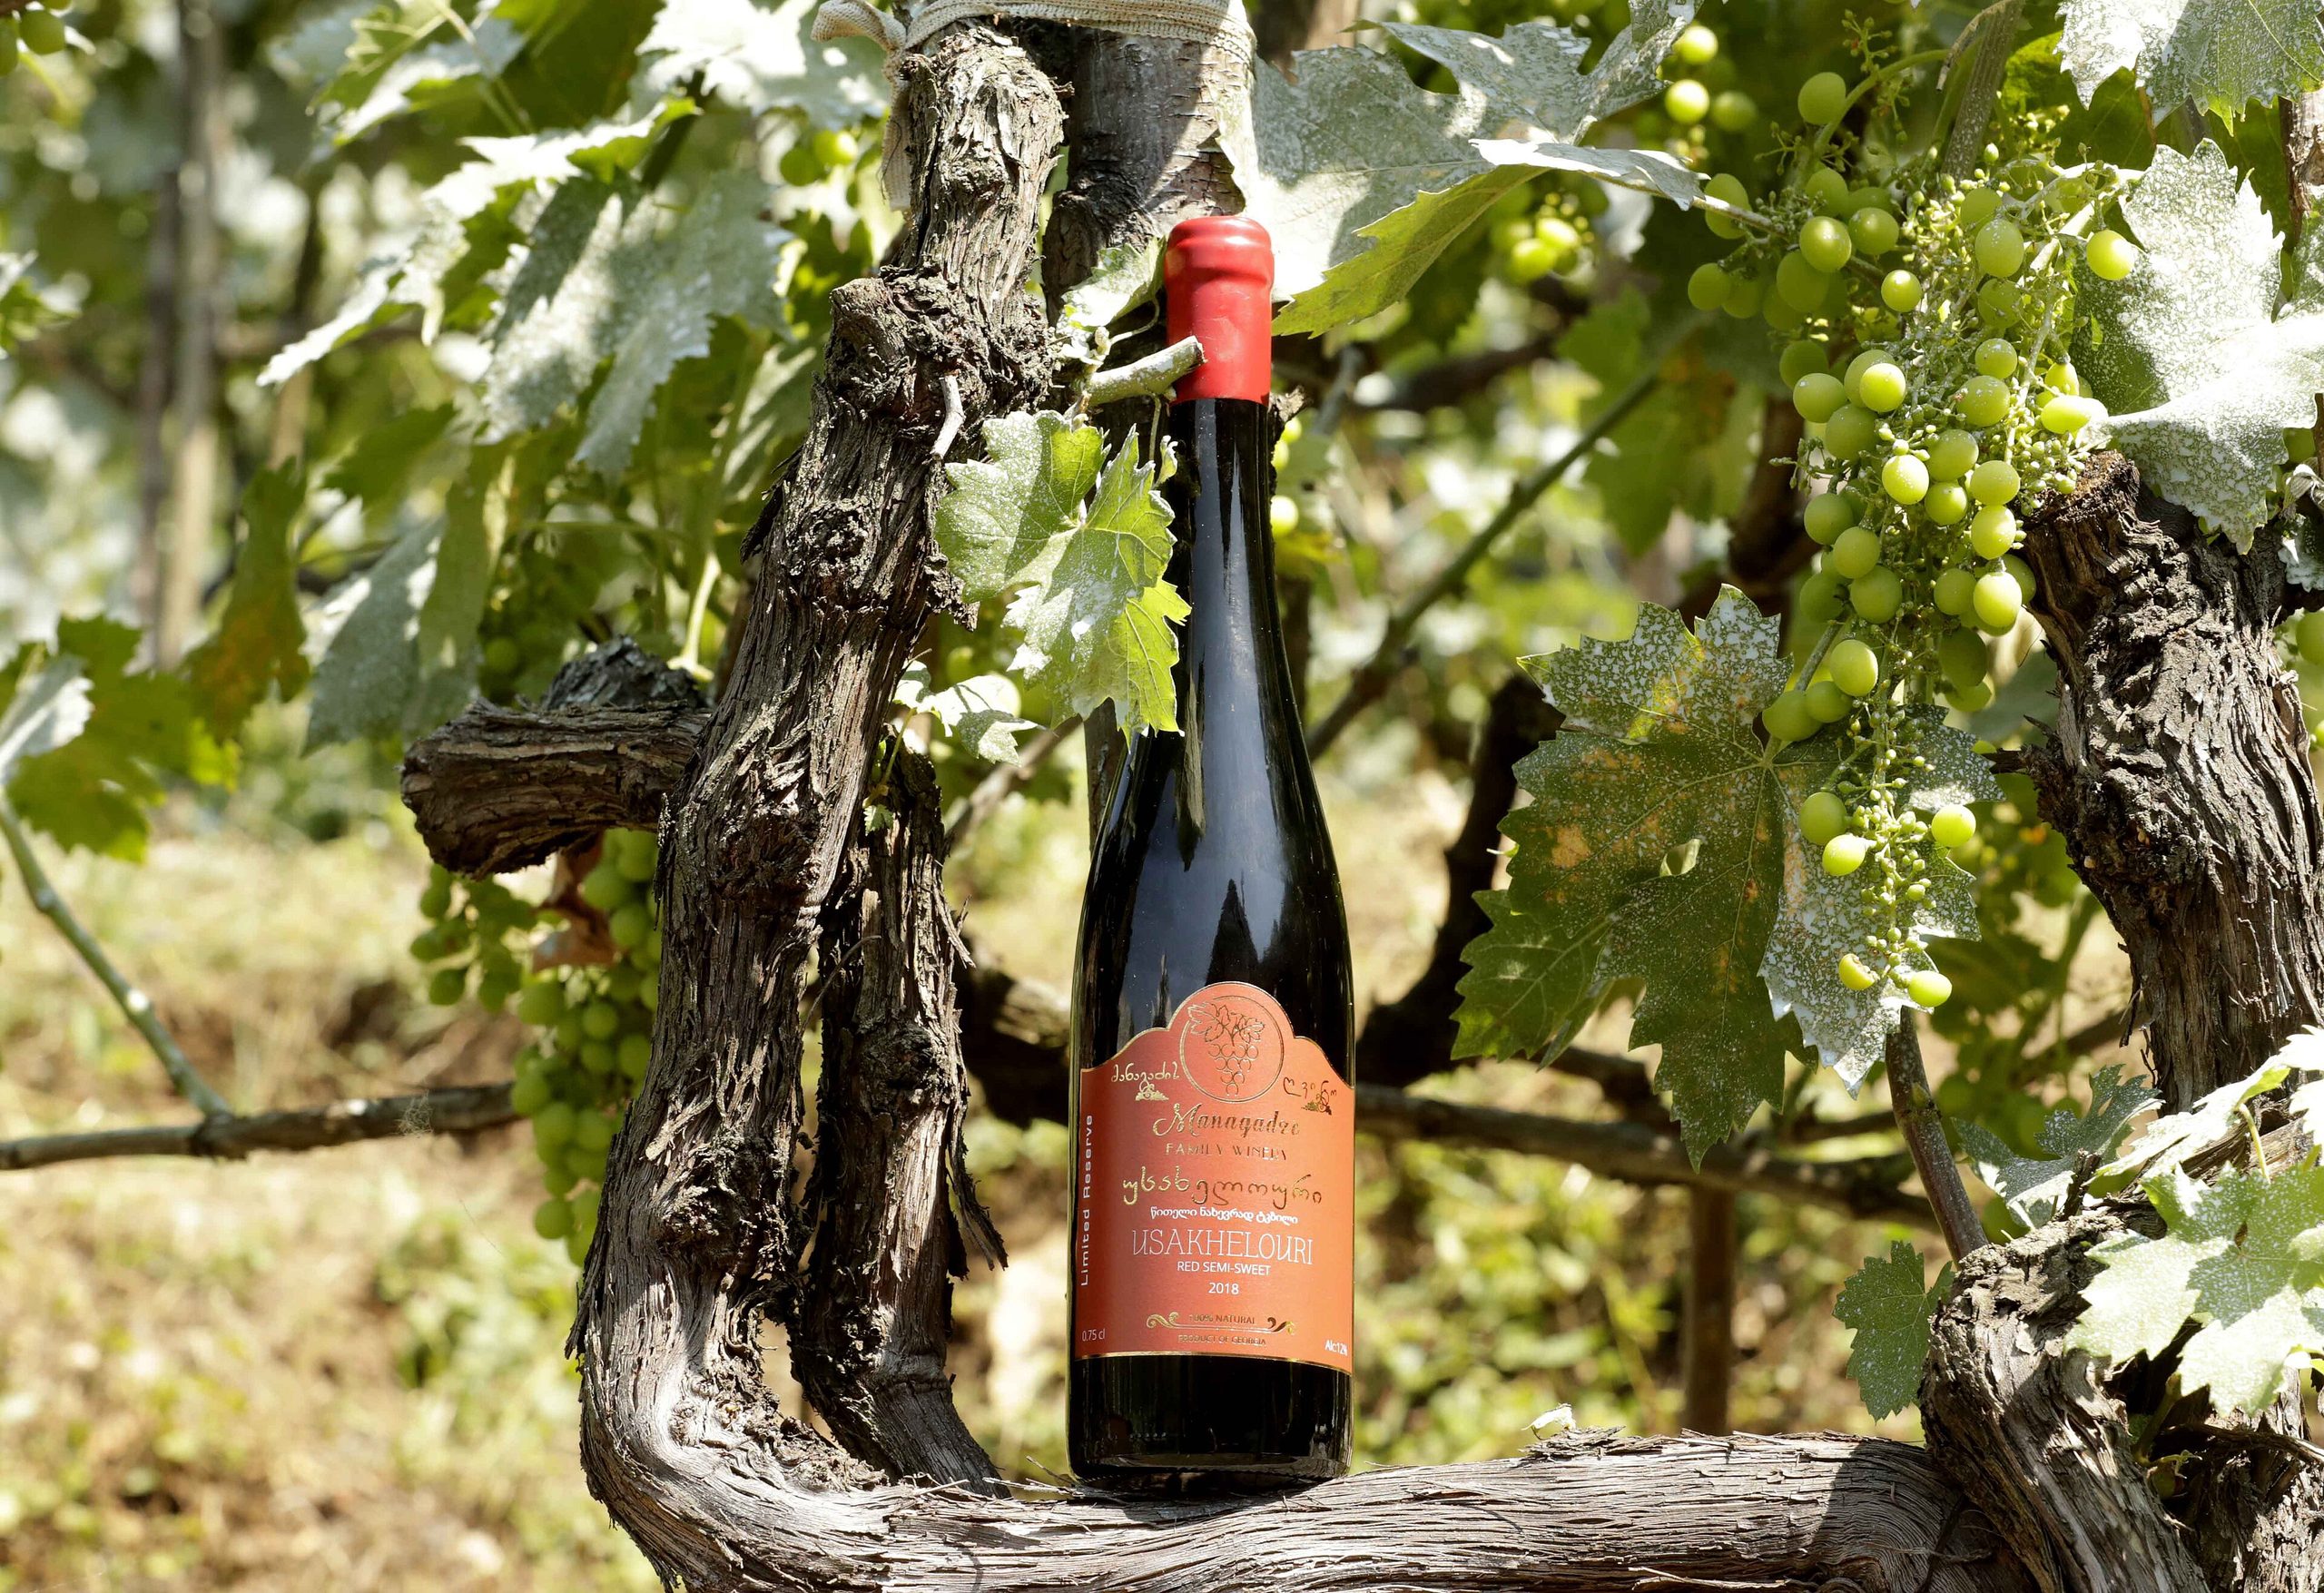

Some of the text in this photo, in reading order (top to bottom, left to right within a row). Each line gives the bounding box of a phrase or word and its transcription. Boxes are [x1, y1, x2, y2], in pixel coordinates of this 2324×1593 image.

[1152, 1102, 1301, 1137] Managadze
[1165, 1142, 1223, 1156] FAMILY
[1122, 1165, 1323, 1210] უსახელოური
[1080, 1115, 1093, 1286] Limited Reserve
[1150, 1205, 1299, 1226] წითელი ნახევრად ტკბილი
[1132, 1228, 1314, 1265] USAKHELOURI
[1177, 1261, 1271, 1276] RED SEMI-SWEET
[1208, 1282, 1239, 1295] 2018
[1216, 1314, 1256, 1324] NATURAL
[1081, 1329, 1098, 1342] 0.75
[1177, 1333, 1266, 1347] PRODUCT OF GEORGIA
